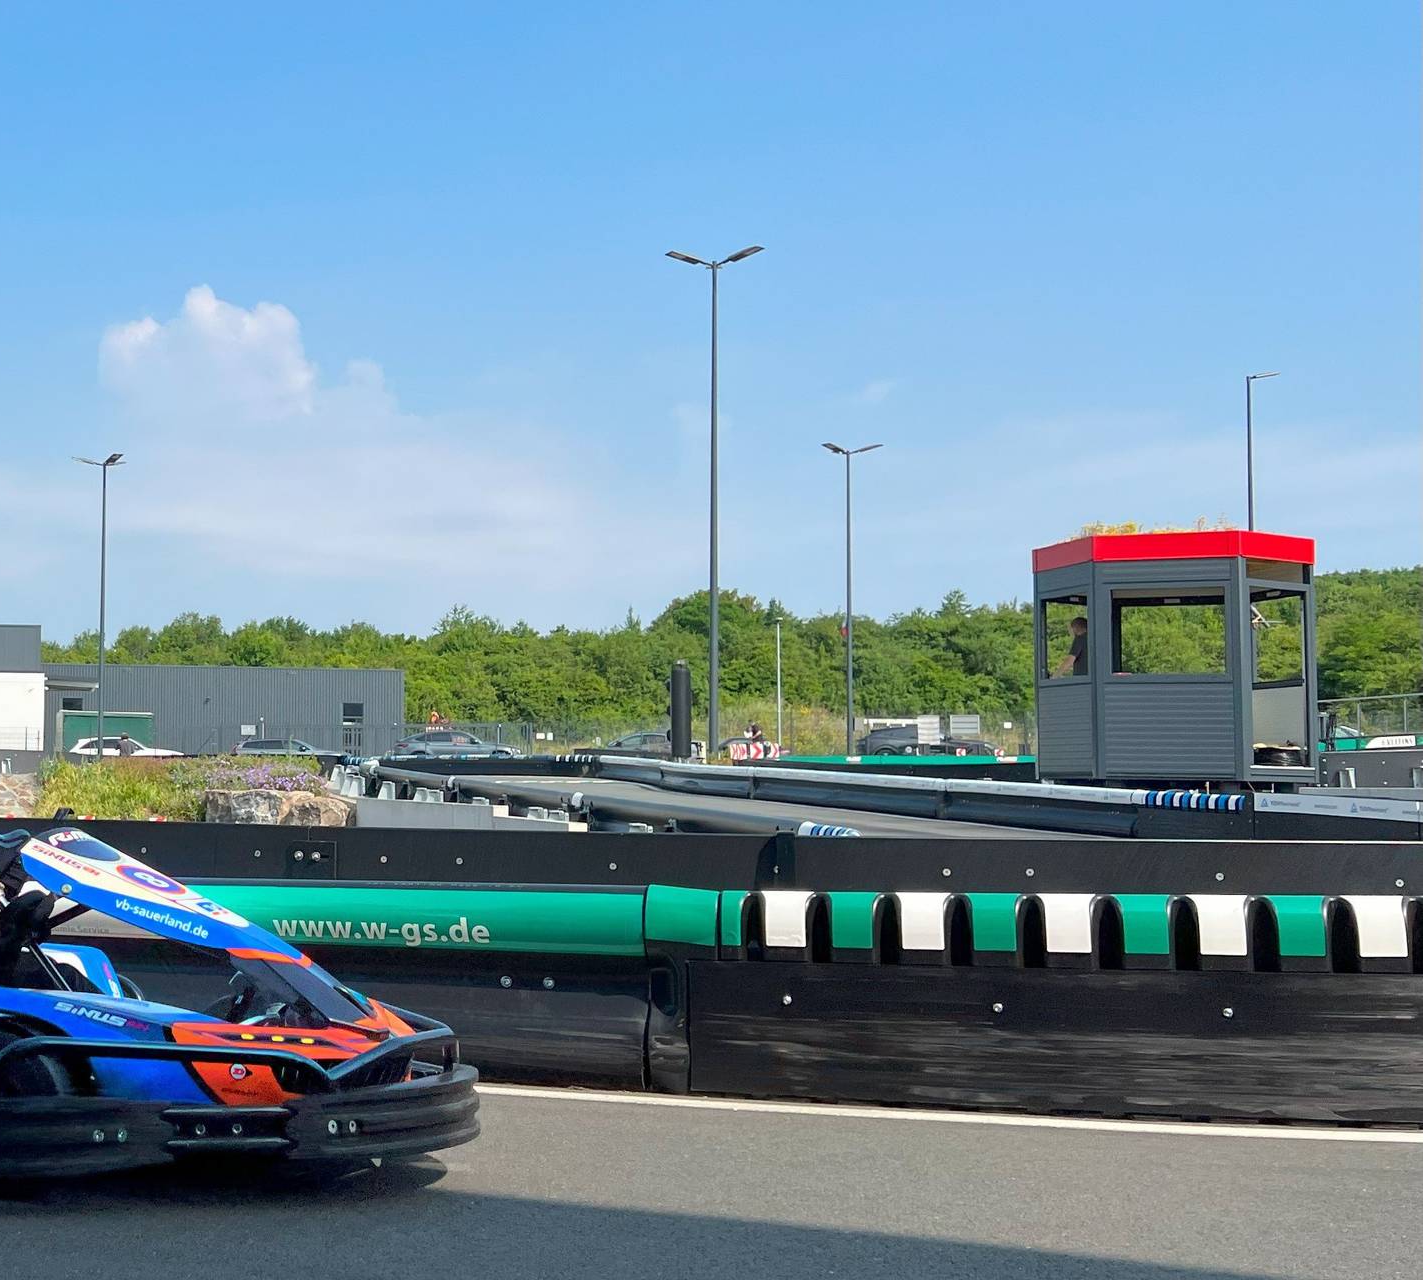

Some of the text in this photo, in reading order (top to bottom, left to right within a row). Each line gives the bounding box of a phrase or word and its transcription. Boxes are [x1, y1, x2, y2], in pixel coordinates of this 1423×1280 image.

[133, 871, 170, 888] 8
[115, 899, 209, 940] vb-sauerland.de
[272, 916, 491, 948] www.w-gs.de
